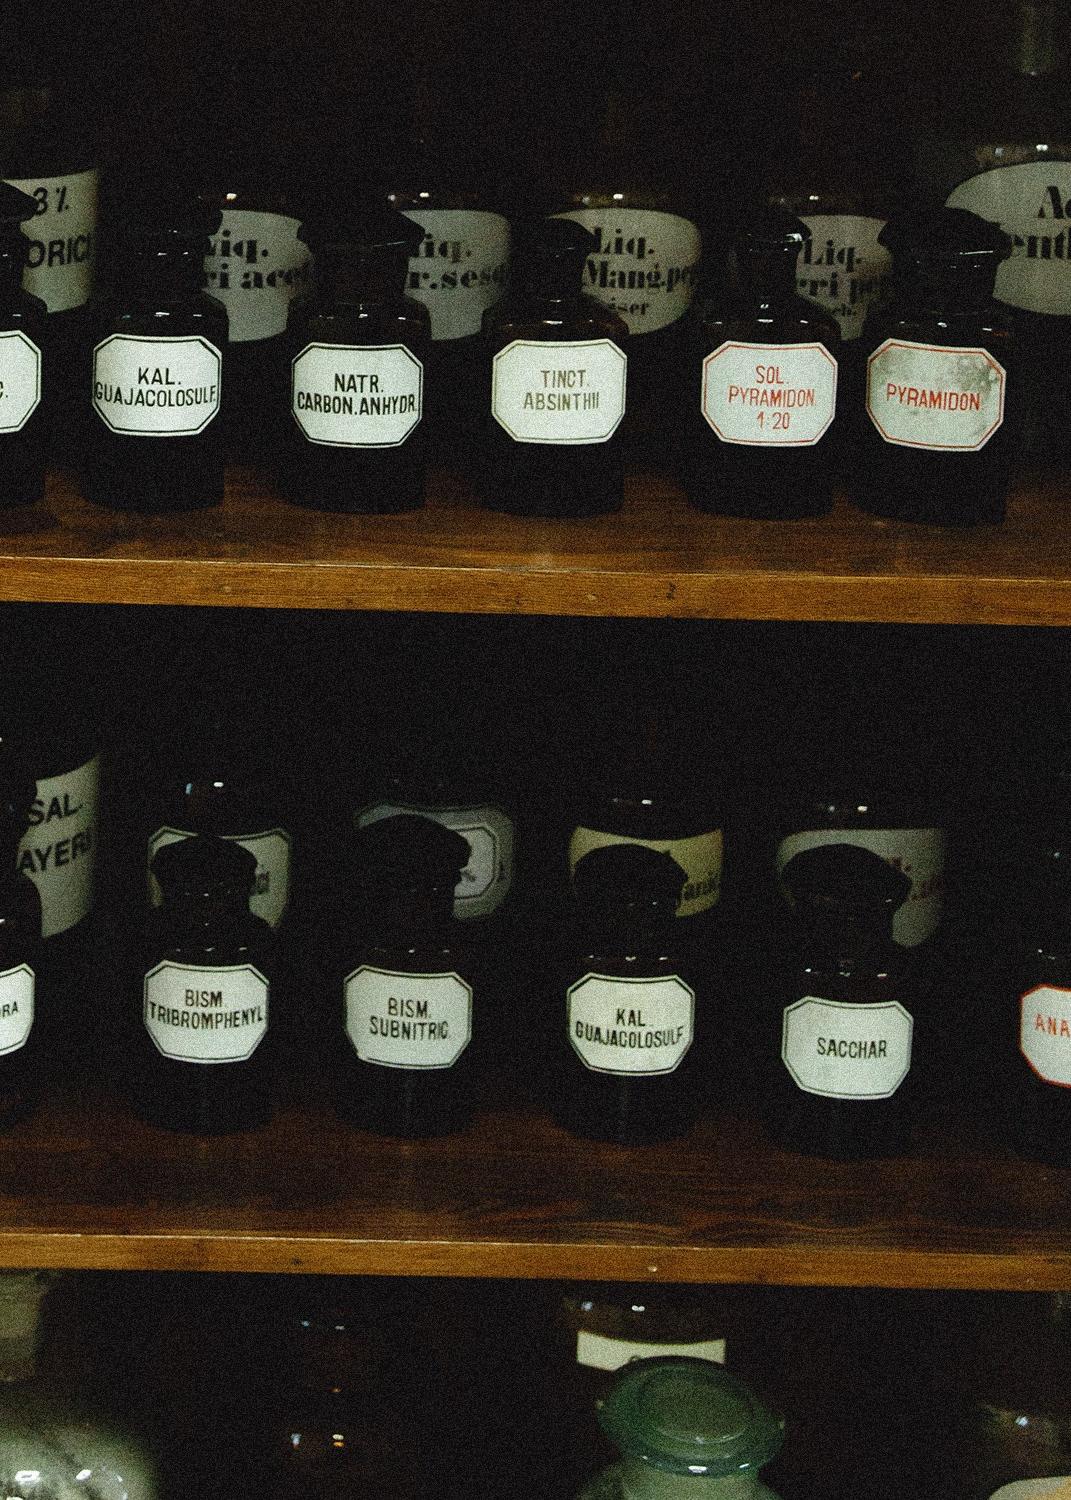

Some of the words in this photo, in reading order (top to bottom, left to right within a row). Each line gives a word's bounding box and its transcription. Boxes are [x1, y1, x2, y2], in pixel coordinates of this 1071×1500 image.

[418, 233, 471, 264] iq.
[137, 366, 182, 385] KAL.
[334, 372, 384, 393] NATR.
[539, 369, 590, 388] TINCT.
[755, 365, 790, 384] SOL.
[95, 382, 216, 406] GUAJACOLOSULF.
[523, 392, 600, 410] ABSINTHII
[756, 411, 790, 429] 1:20
[369, 1016, 449, 1041] SUBNITRIC
[575, 1020, 684, 1049] GUAJACOLOSULF
[816, 1036, 888, 1059] SACCHAR
